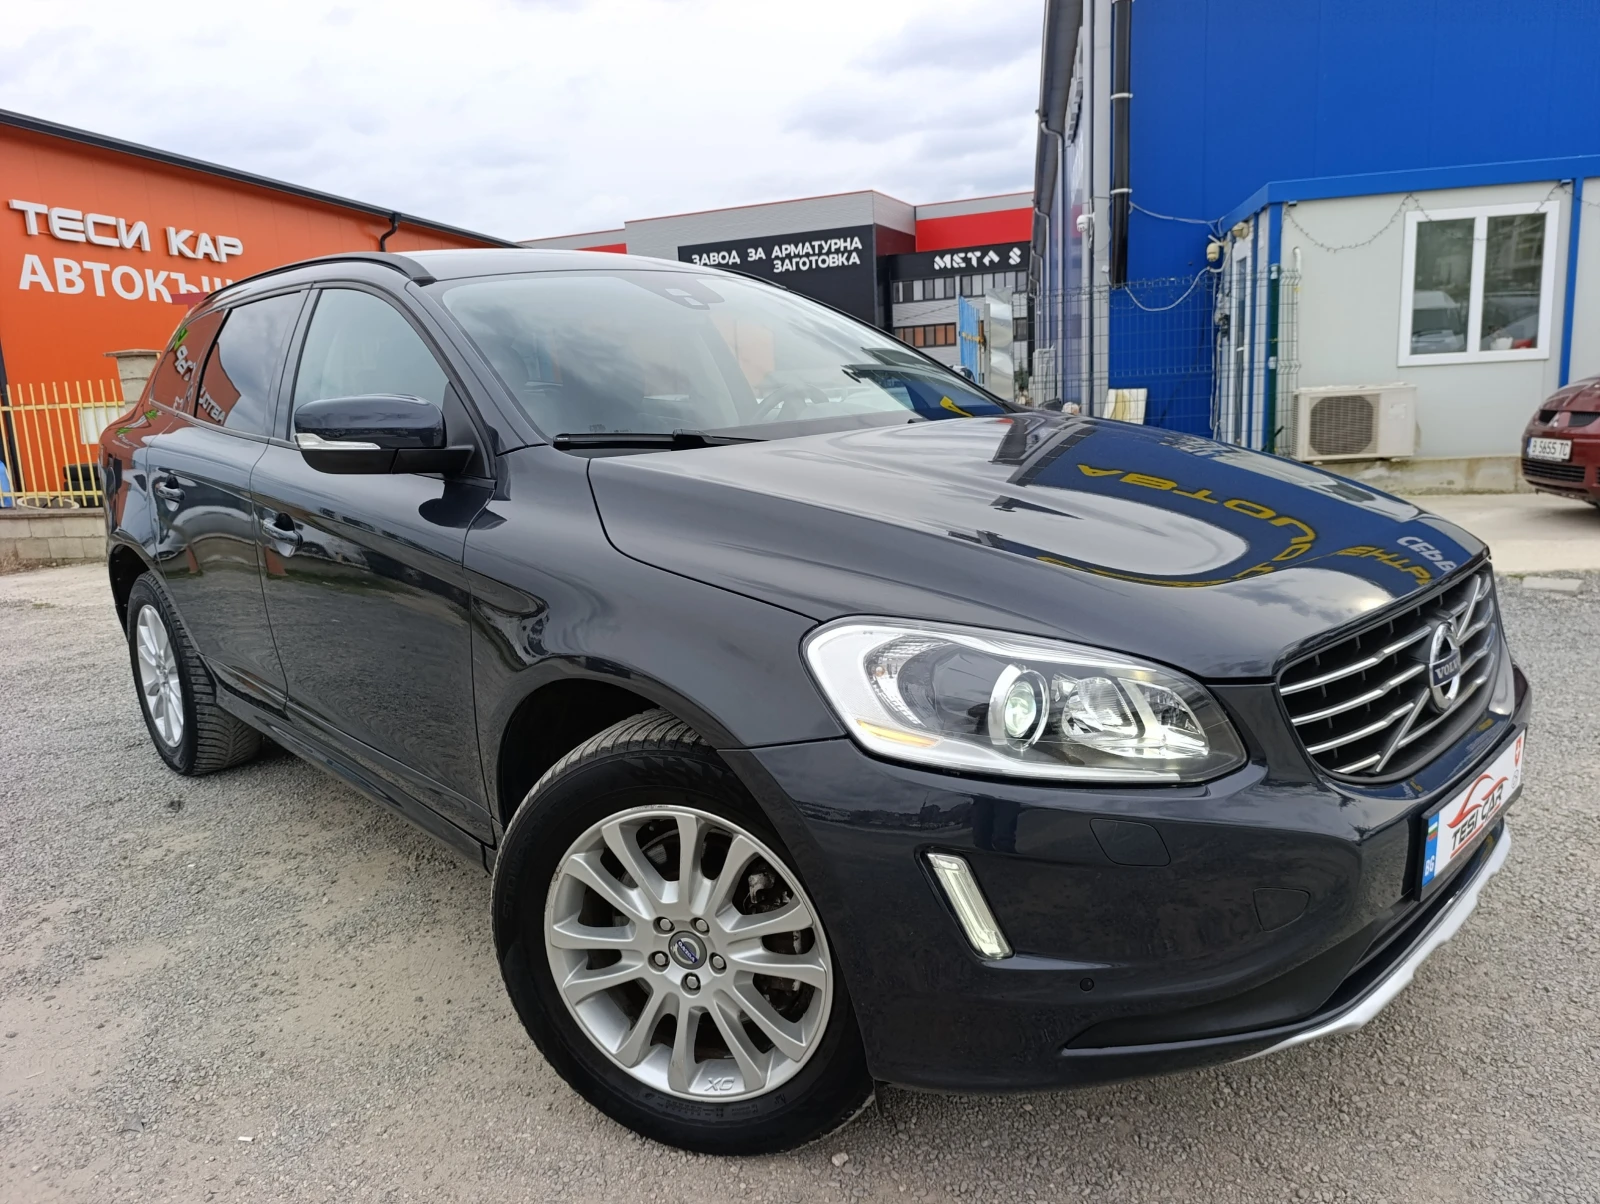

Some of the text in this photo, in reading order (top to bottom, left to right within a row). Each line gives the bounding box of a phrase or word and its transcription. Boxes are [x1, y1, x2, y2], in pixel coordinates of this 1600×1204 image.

[9, 199, 244, 263] ТЕСИ КАР
[691, 236, 862, 266] ЗАВОД ЗА АРМАТУРНА
[773, 252, 860, 273] ЗАГОТОВКА
[1451, 782, 1504, 850] TESI CAR
[1424, 854, 1436, 876] BG
